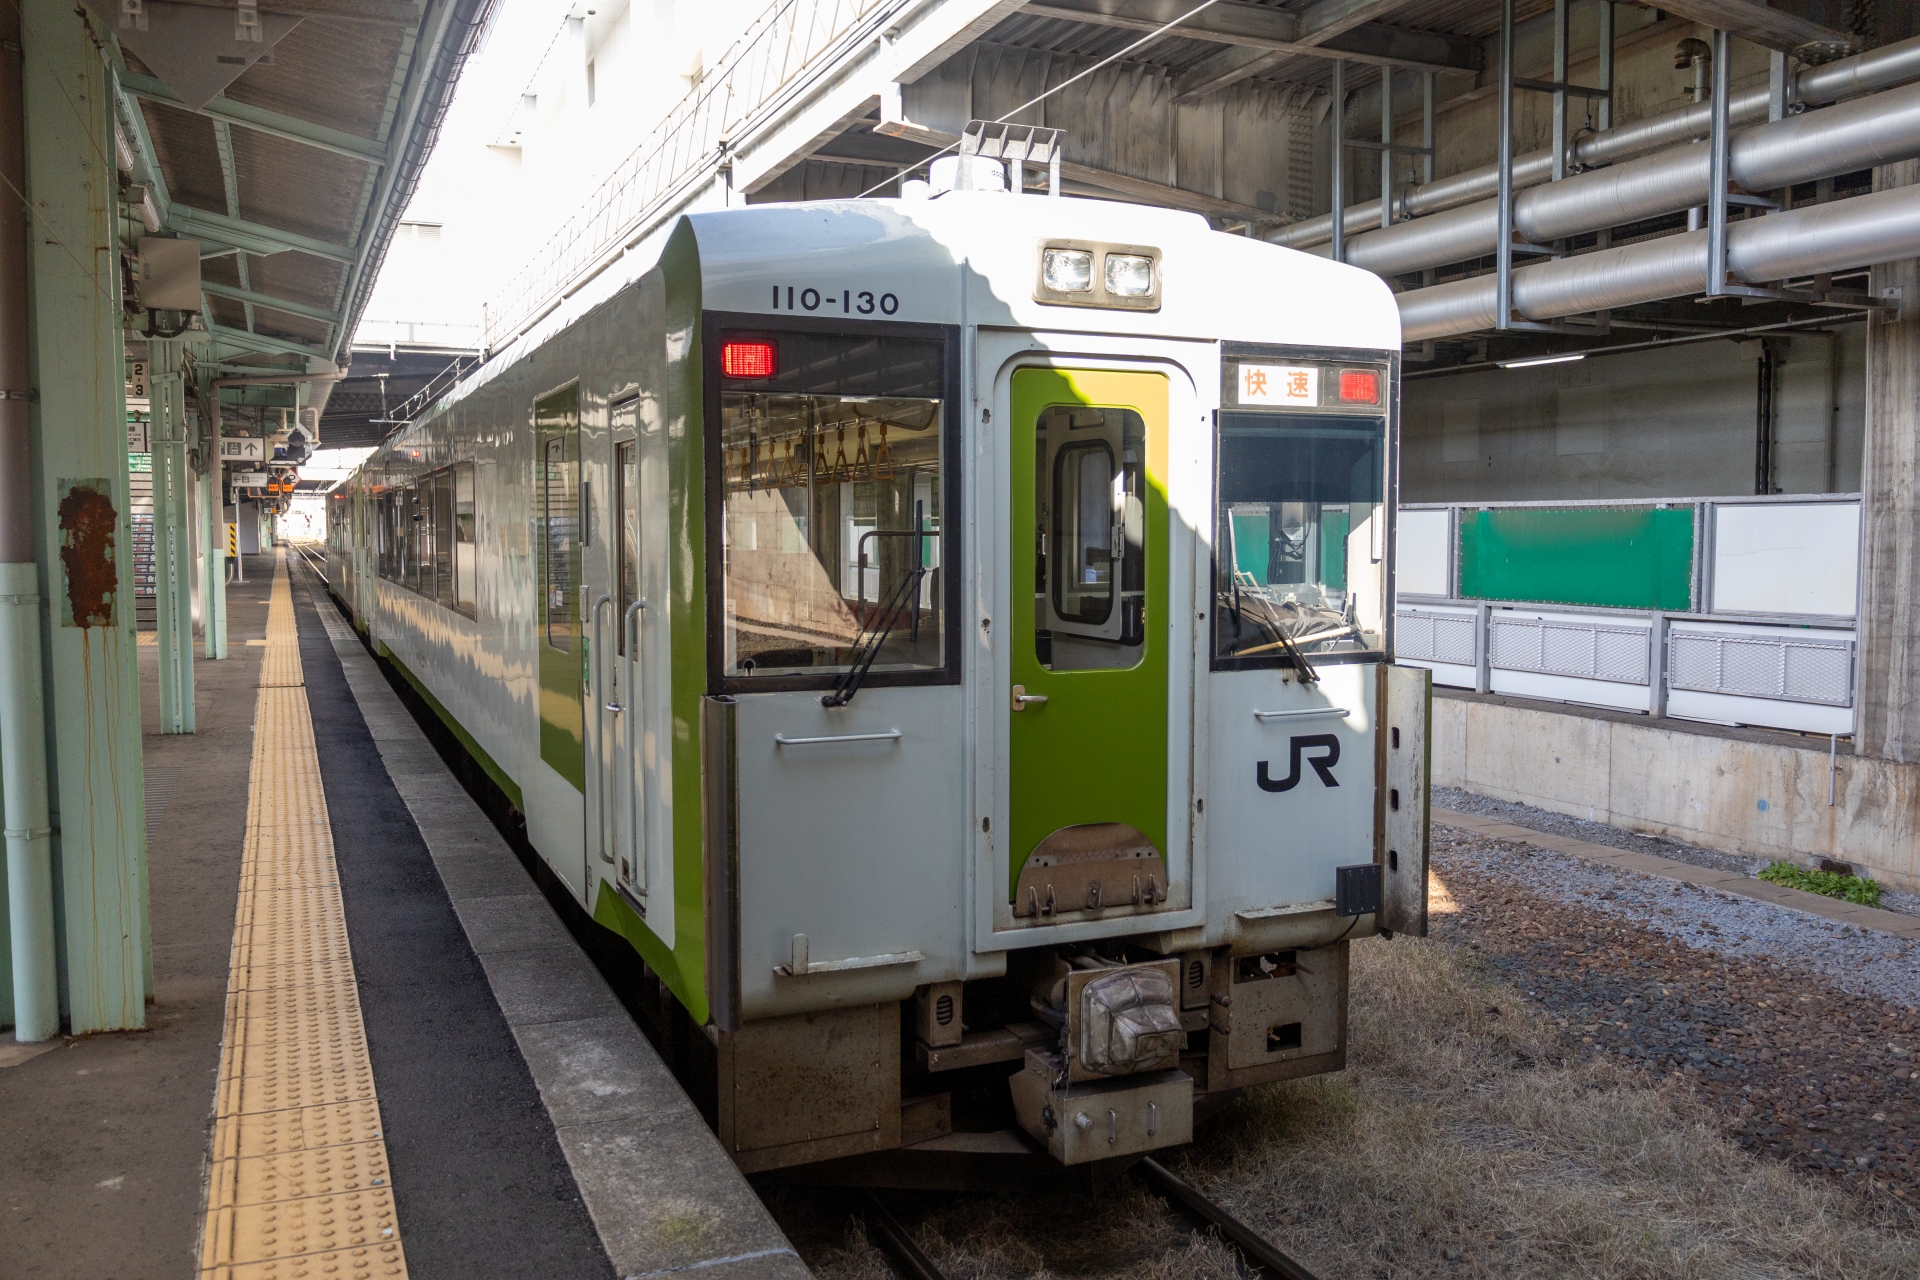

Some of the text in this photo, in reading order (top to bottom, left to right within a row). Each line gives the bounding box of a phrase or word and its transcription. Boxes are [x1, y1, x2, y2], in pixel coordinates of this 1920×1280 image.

[772, 285, 899, 316] 110-130
[1244, 368, 1309, 398] 快速
[1257, 733, 1340, 793] JR
